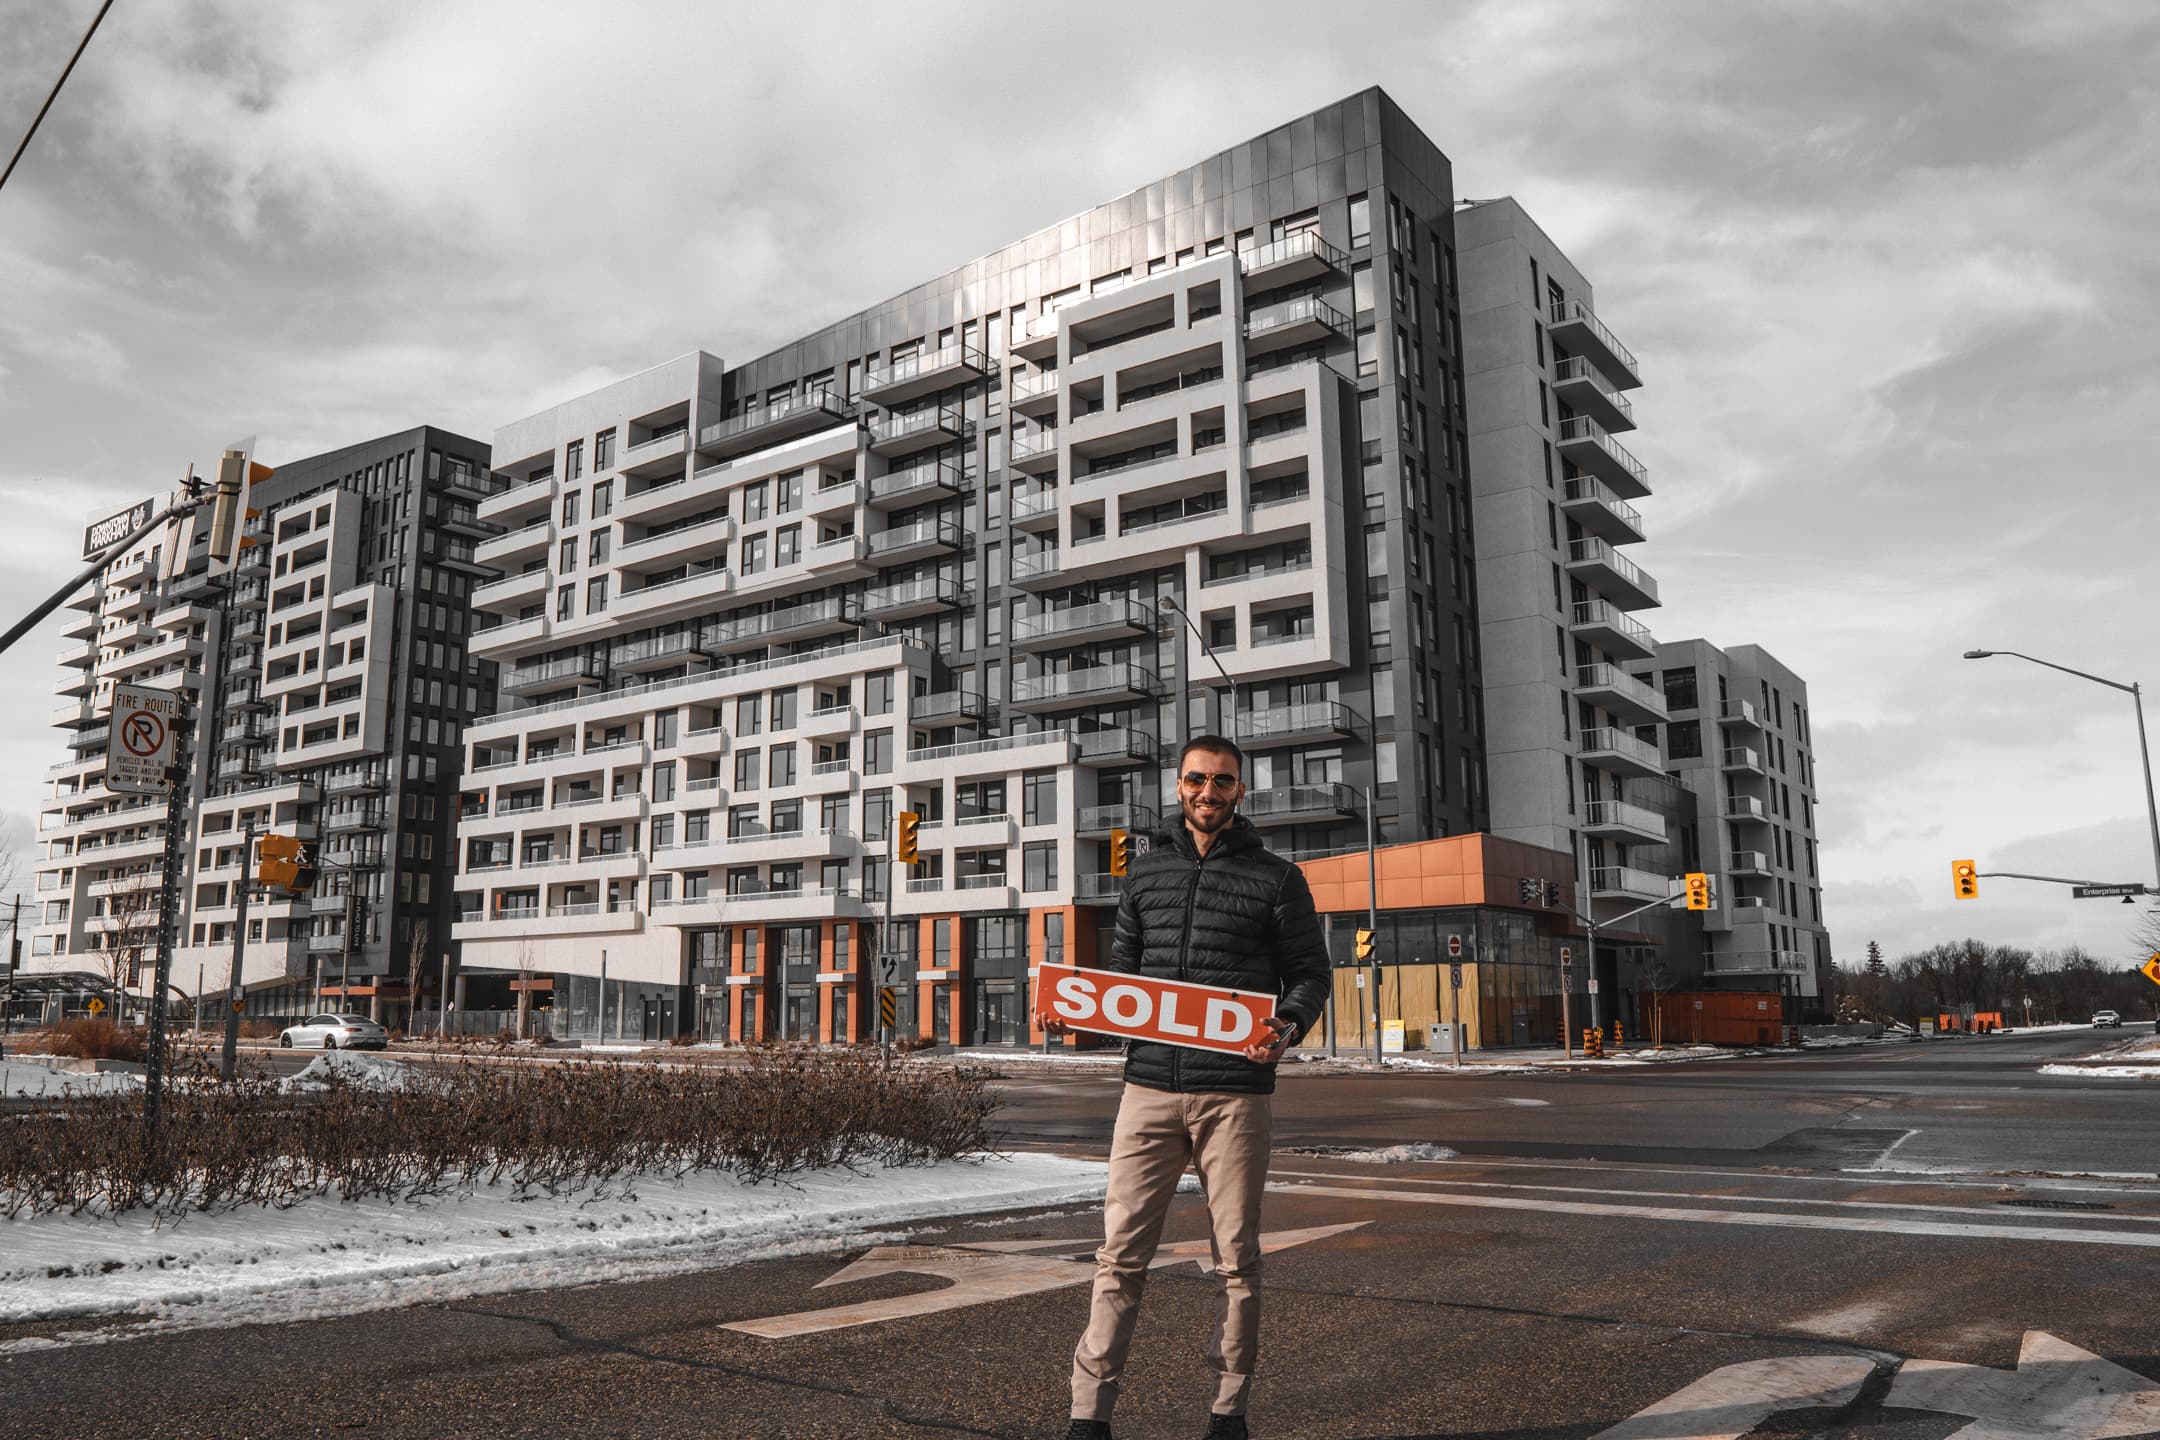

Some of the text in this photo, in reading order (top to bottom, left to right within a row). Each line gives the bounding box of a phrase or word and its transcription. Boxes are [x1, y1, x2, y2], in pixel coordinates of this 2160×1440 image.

[91, 511, 130, 539] DOWNTOWN
[90, 521, 128, 551] MARKHAM
[116, 694, 174, 714] FIRE ROUTE
[116, 756, 140, 766] VEHICLES
[143, 758, 155, 767] WILL
[119, 765, 161, 776] TAGGED AND/OR
[122, 774, 155, 785] TOWED AWAY
[2082, 888, 2121, 896] Enterprise
[1053, 977, 1253, 1042] SOLD
